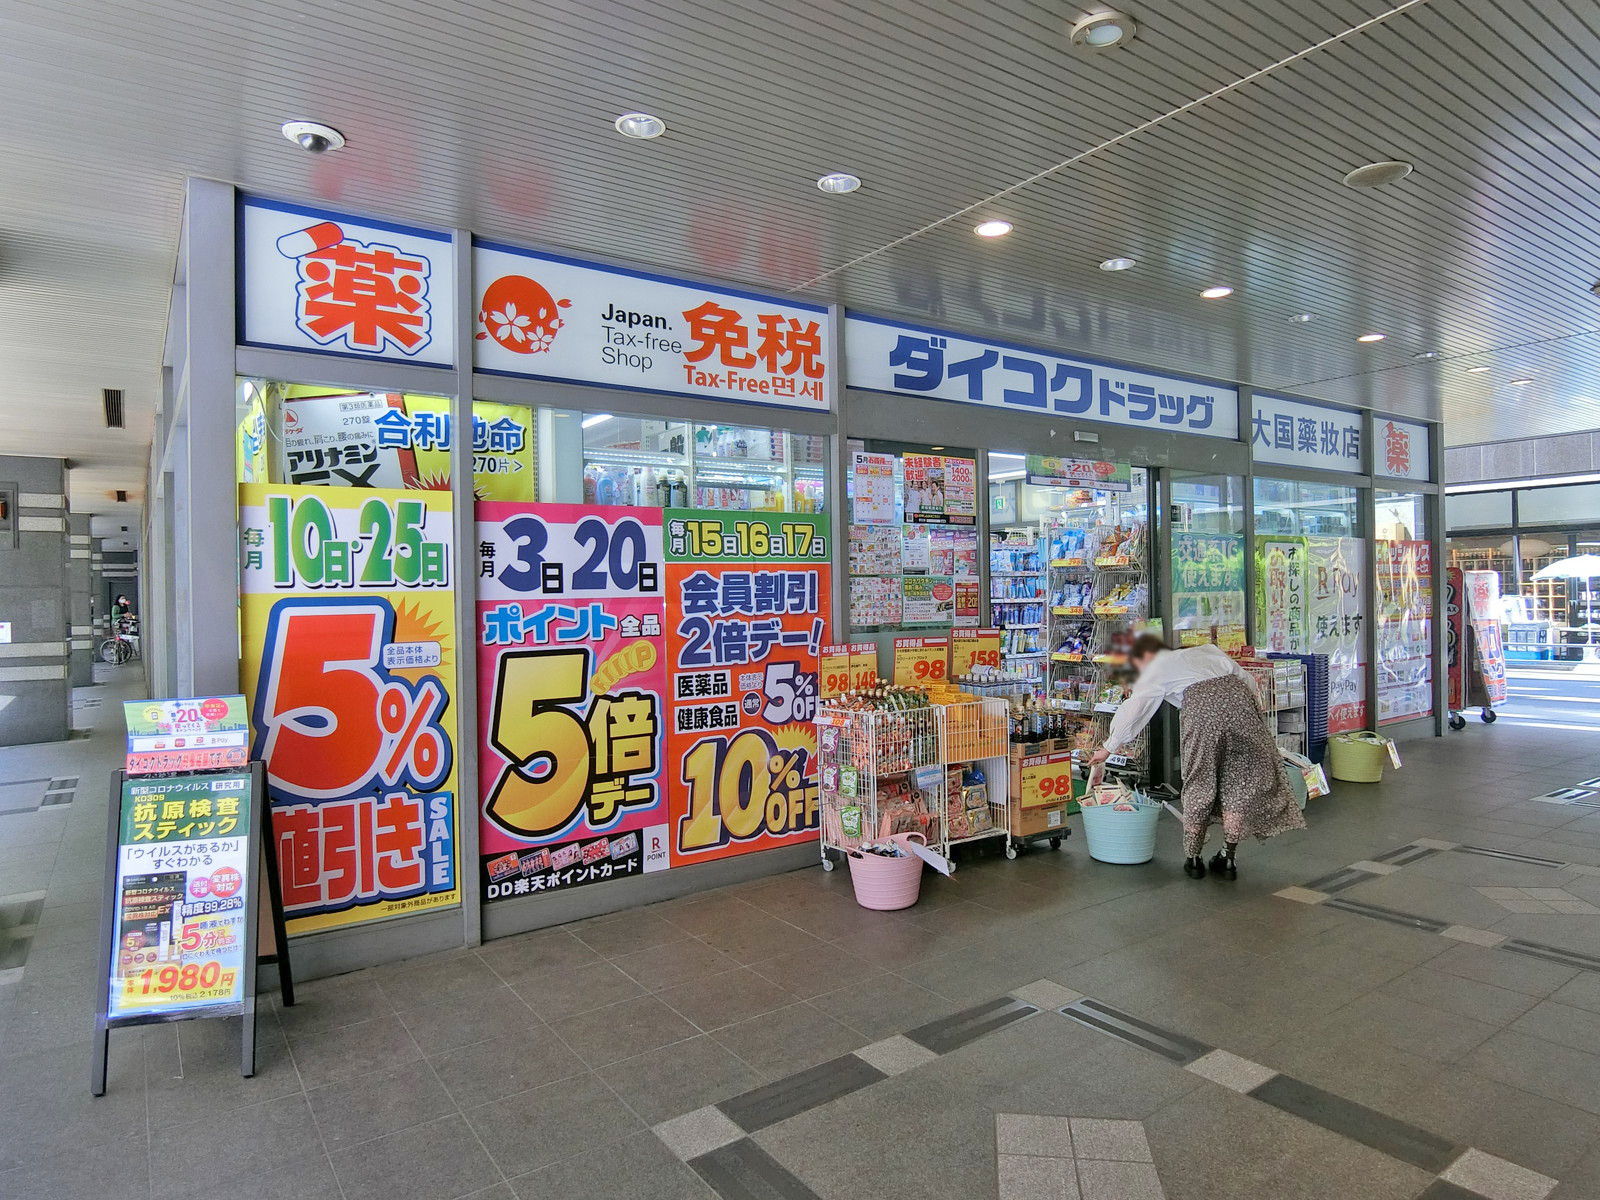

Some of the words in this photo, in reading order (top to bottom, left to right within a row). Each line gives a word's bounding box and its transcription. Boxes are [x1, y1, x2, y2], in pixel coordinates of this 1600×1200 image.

[303, 243, 424, 349] 薬
[601, 303, 673, 331] Japan.
[601, 325, 683, 354] Tax-free
[681, 300, 826, 379] 免税
[601, 346, 653, 373] Shop
[682, 364, 770, 395] Tax-Free
[889, 334, 1215, 430] ダイコクドラッグ
[343, 415, 371, 426] 270錠
[287, 443, 378, 472] アリナミン
[904, 457, 942, 468] 未経験者
[1386, 428, 1410, 474] 薬
[243, 527, 265, 570] 毎月
[670, 520, 685, 553] 毎月
[479, 540, 496, 578] 毎月
[497, 517, 564, 594] 3日
[571, 519, 658, 592] 20日
[682, 572, 818, 615] 会員割引
[484, 603, 617, 643] ポイント
[620, 613, 661, 637] 全品
[1316, 613, 1363, 640] 使えます
[386, 645, 424, 656] 全品本体
[679, 616, 824, 666] 2倍デー!
[386, 654, 439, 666] 表示価格より
[913, 659, 945, 680] 98
[677, 673, 728, 698] 医薬品
[827, 673, 849, 693] 98
[855, 670, 876, 690] 148
[1330, 681, 1358, 699] PayPay
[677, 703, 738, 732] 健康食品
[131, 783, 209, 795] 新型コロナウイルス
[215, 781, 241, 789] 研究用
[1039, 774, 1070, 799] 98
[133, 797, 240, 822] 抗原検査
[133, 816, 239, 841] スティック
[428, 796, 450, 886] SALE
[153, 854, 213, 869] すぐわかる
[271, 796, 423, 907] 値引き
[646, 852, 666, 861] POINT
[212, 873, 240, 884] 変異株
[216, 882, 235, 892] 対応
[181, 897, 242, 917] 精度99.28%
